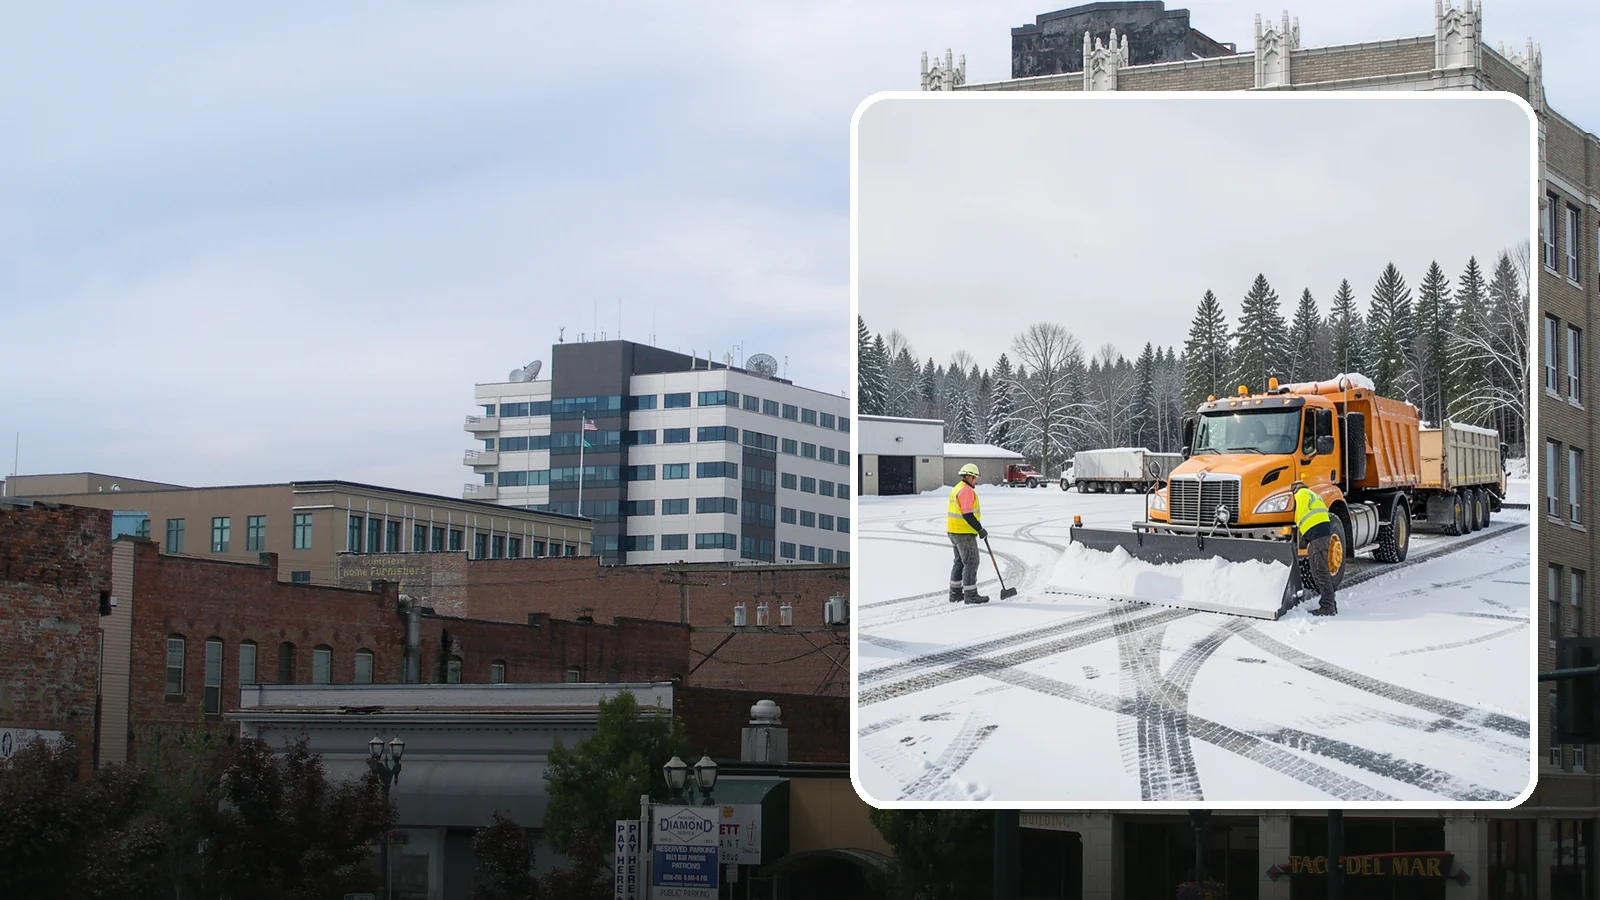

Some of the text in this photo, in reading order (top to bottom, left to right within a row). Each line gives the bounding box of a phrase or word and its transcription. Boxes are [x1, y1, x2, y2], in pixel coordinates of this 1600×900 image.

[370, 566, 426, 577] Furnishers
[660, 818, 713, 833] DIAMOND
[719, 824, 740, 835] ETT
[656, 845, 716, 854] RESERVED PARKING
[627, 824, 637, 893] PAY HERE
[722, 852, 739, 862] Soup
[671, 862, 701, 870] PATRONS
[1346, 856, 1385, 876] DEL
[1392, 857, 1443, 877] MAR
[617, 856, 625, 893] HERE
[700, 874, 708, 882] PM
[661, 888, 710, 898] PUBLIC PARKING
